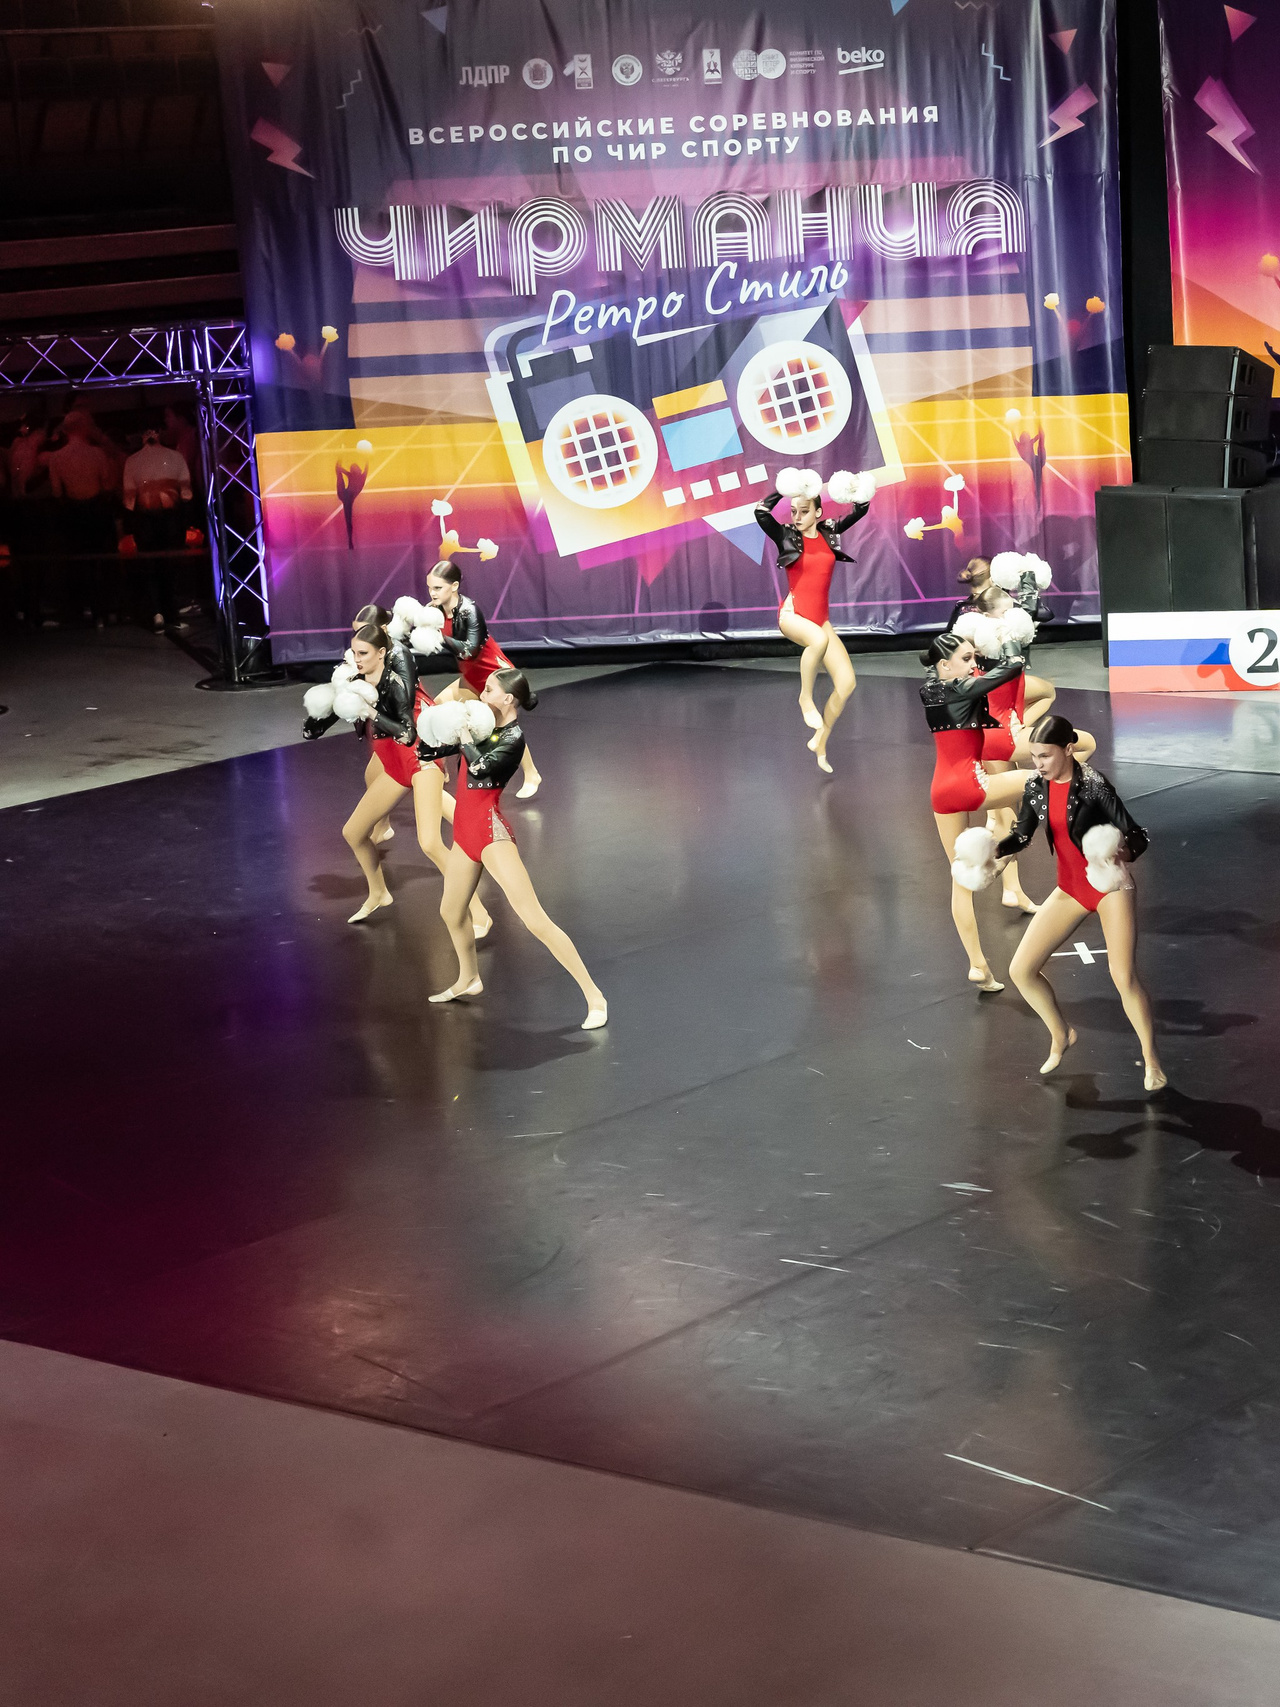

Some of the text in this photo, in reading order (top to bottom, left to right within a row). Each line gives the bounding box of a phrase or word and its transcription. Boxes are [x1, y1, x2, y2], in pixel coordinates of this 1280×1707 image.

[837, 47, 885, 64] beko
[459, 65, 510, 87] ЛДПР
[408, 105, 939, 145] ВСЕРОССИЙСКИЕ СОРЕВНОВАНИЯ
[552, 136, 800, 164] ПО ЧИР СПОРТУ
[541, 260, 849, 346] Ретро Стиль
[1246, 627, 1280, 674] 2
